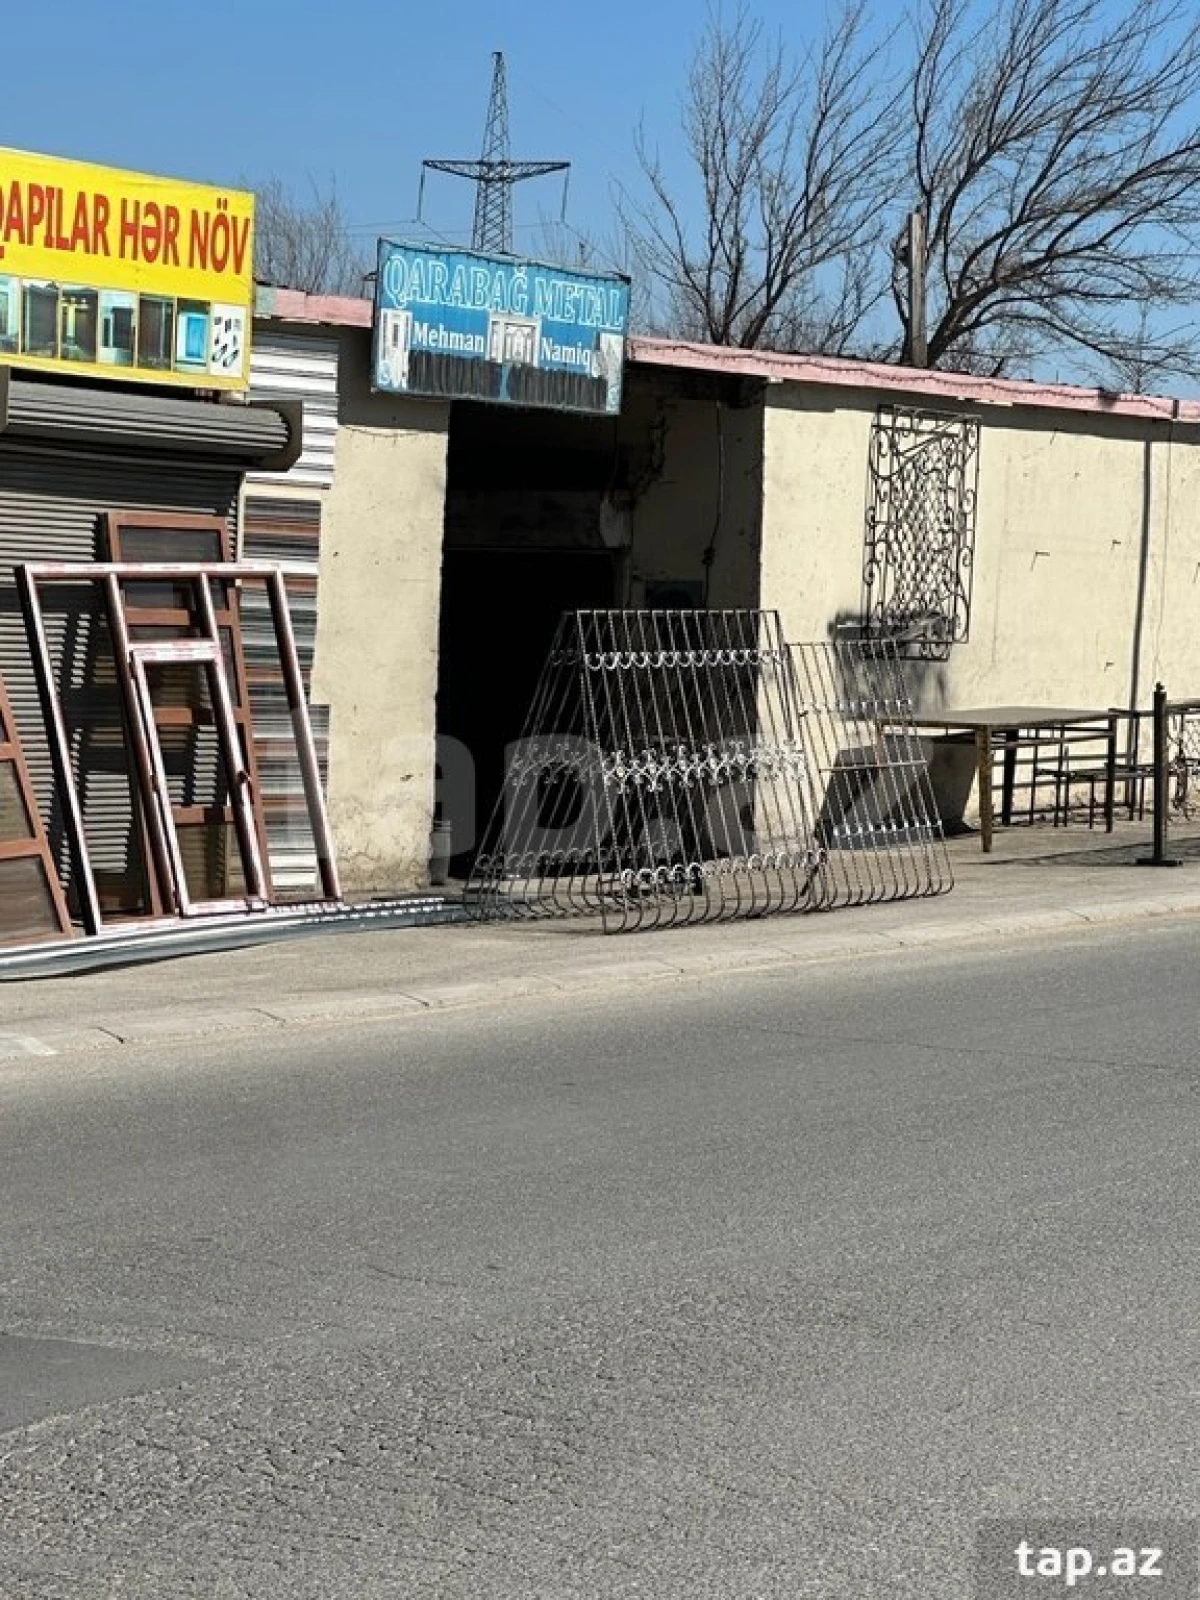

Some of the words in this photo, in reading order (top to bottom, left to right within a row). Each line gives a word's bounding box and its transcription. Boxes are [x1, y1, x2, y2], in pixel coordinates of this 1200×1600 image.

[0, 180, 110, 257] APILAR
[119, 197, 180, 267] HƏR
[188, 197, 251, 275] NÖV
[383, 254, 529, 317] QARABAĞ
[533, 276, 624, 330] METAL
[412, 322, 485, 353] Mehman
